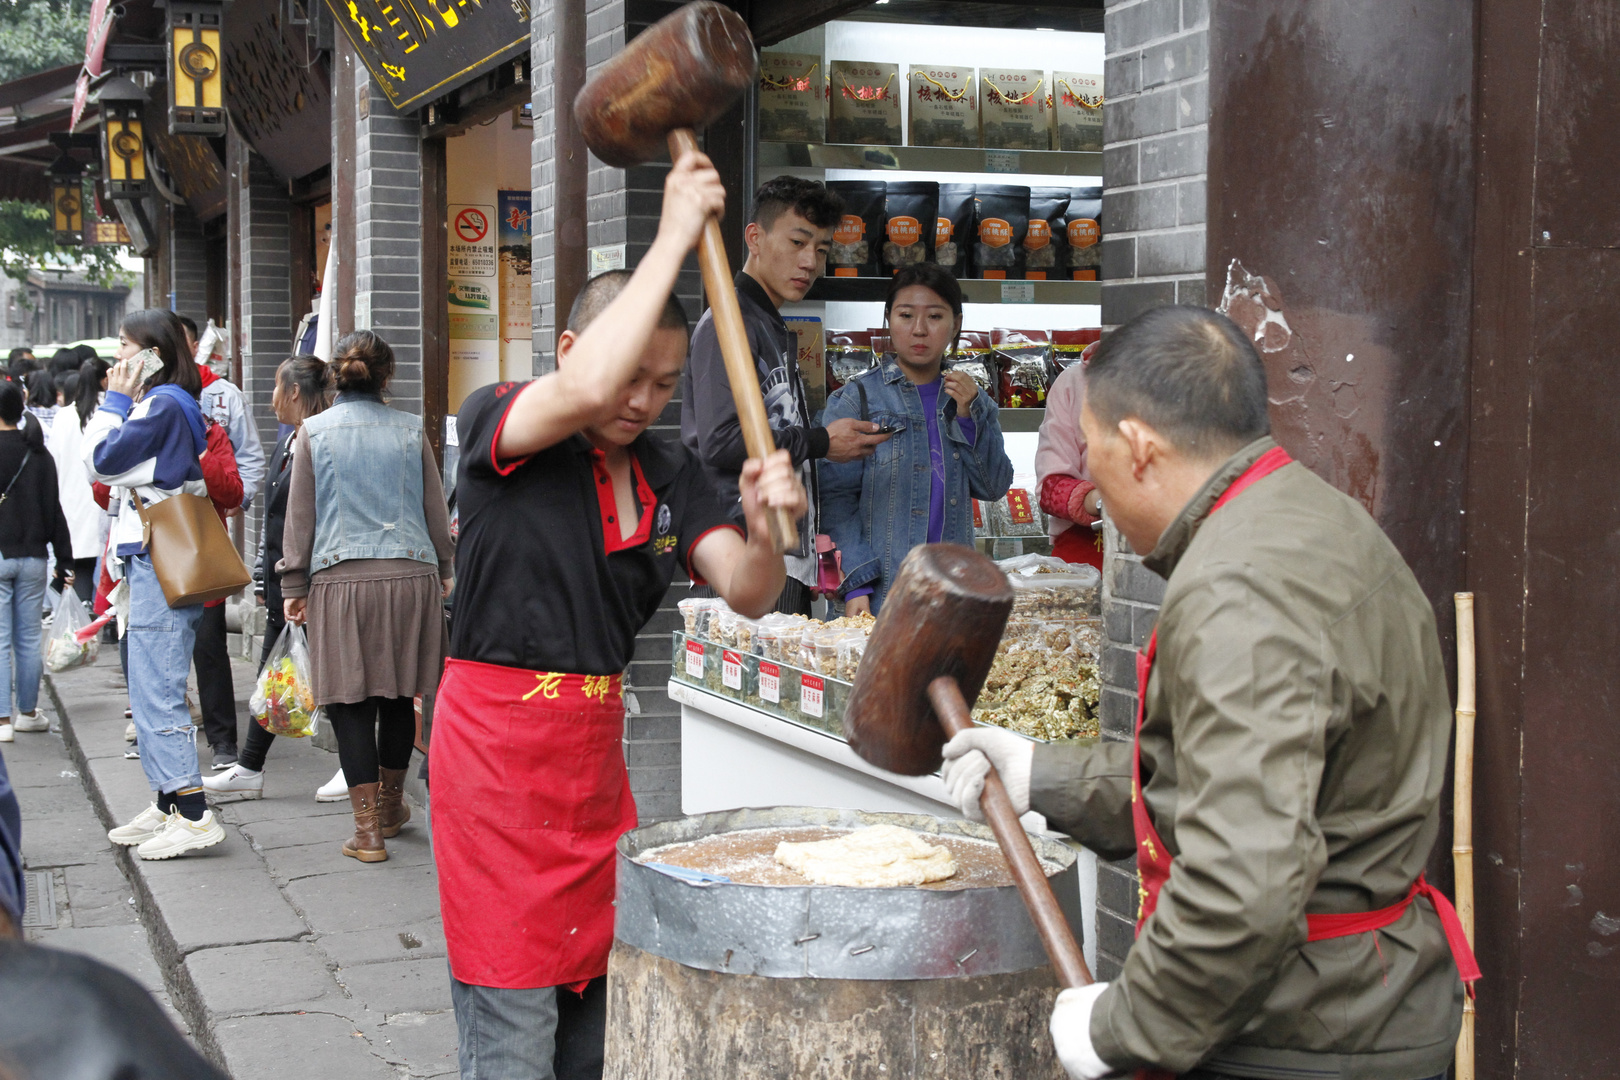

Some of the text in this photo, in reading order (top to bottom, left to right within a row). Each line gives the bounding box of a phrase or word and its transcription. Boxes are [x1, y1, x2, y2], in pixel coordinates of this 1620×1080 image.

[760, 74, 812, 92] 核桃酥
[841, 84, 892, 102] 核桃酥
[916, 85, 968, 104] 核桃酥
[987, 89, 1038, 107] 核桃酥
[890, 225, 917, 235] 核桃酥
[982, 227, 1008, 237] 核桃酥
[1070, 227, 1096, 237] 核桃酥
[450, 246, 493, 254] 本场所内禁止吸烟
